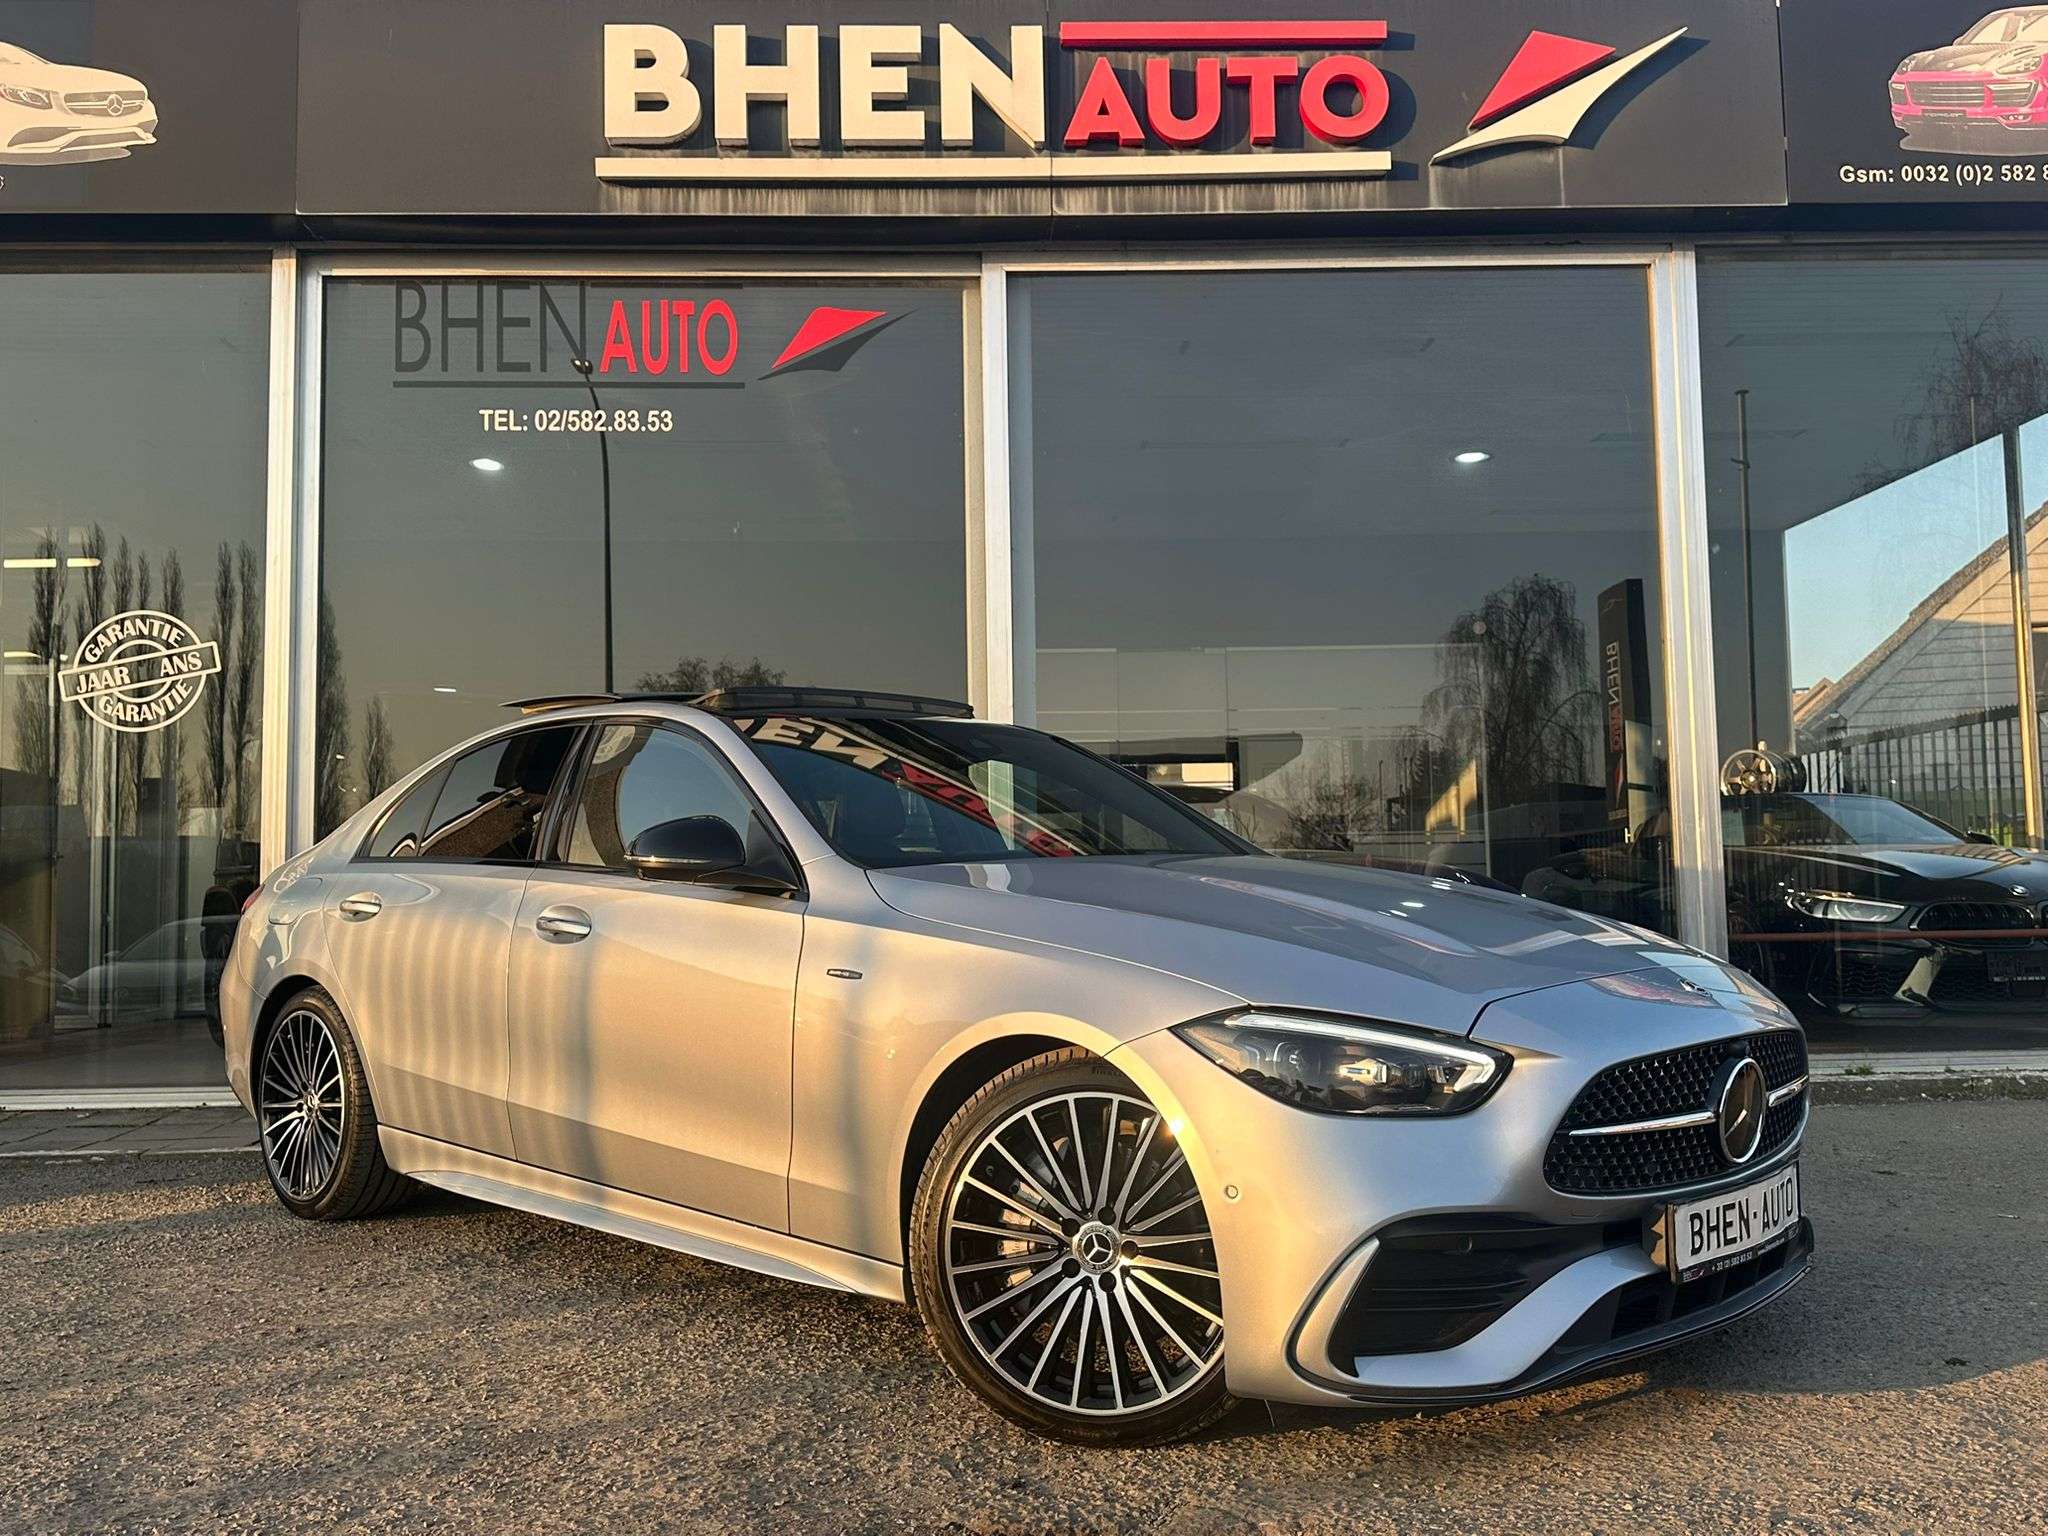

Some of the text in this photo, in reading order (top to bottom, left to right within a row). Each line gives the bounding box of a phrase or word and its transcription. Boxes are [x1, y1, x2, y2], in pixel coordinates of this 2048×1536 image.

[604, 24, 1390, 149] BHEN AUTO
[1839, 165, 1894, 183] Gsm:
[1901, 165, 1949, 182] 0032
[1956, 164, 1993, 187] (0)2
[2000, 164, 2036, 182] 582
[394, 280, 739, 376] BHEN AUTO
[479, 409, 674, 432] TEL: 02/582.83.53
[84, 618, 187, 663] GARANTIE
[76, 651, 202, 694] JAAR ANS
[99, 678, 193, 723] GARANTIE
